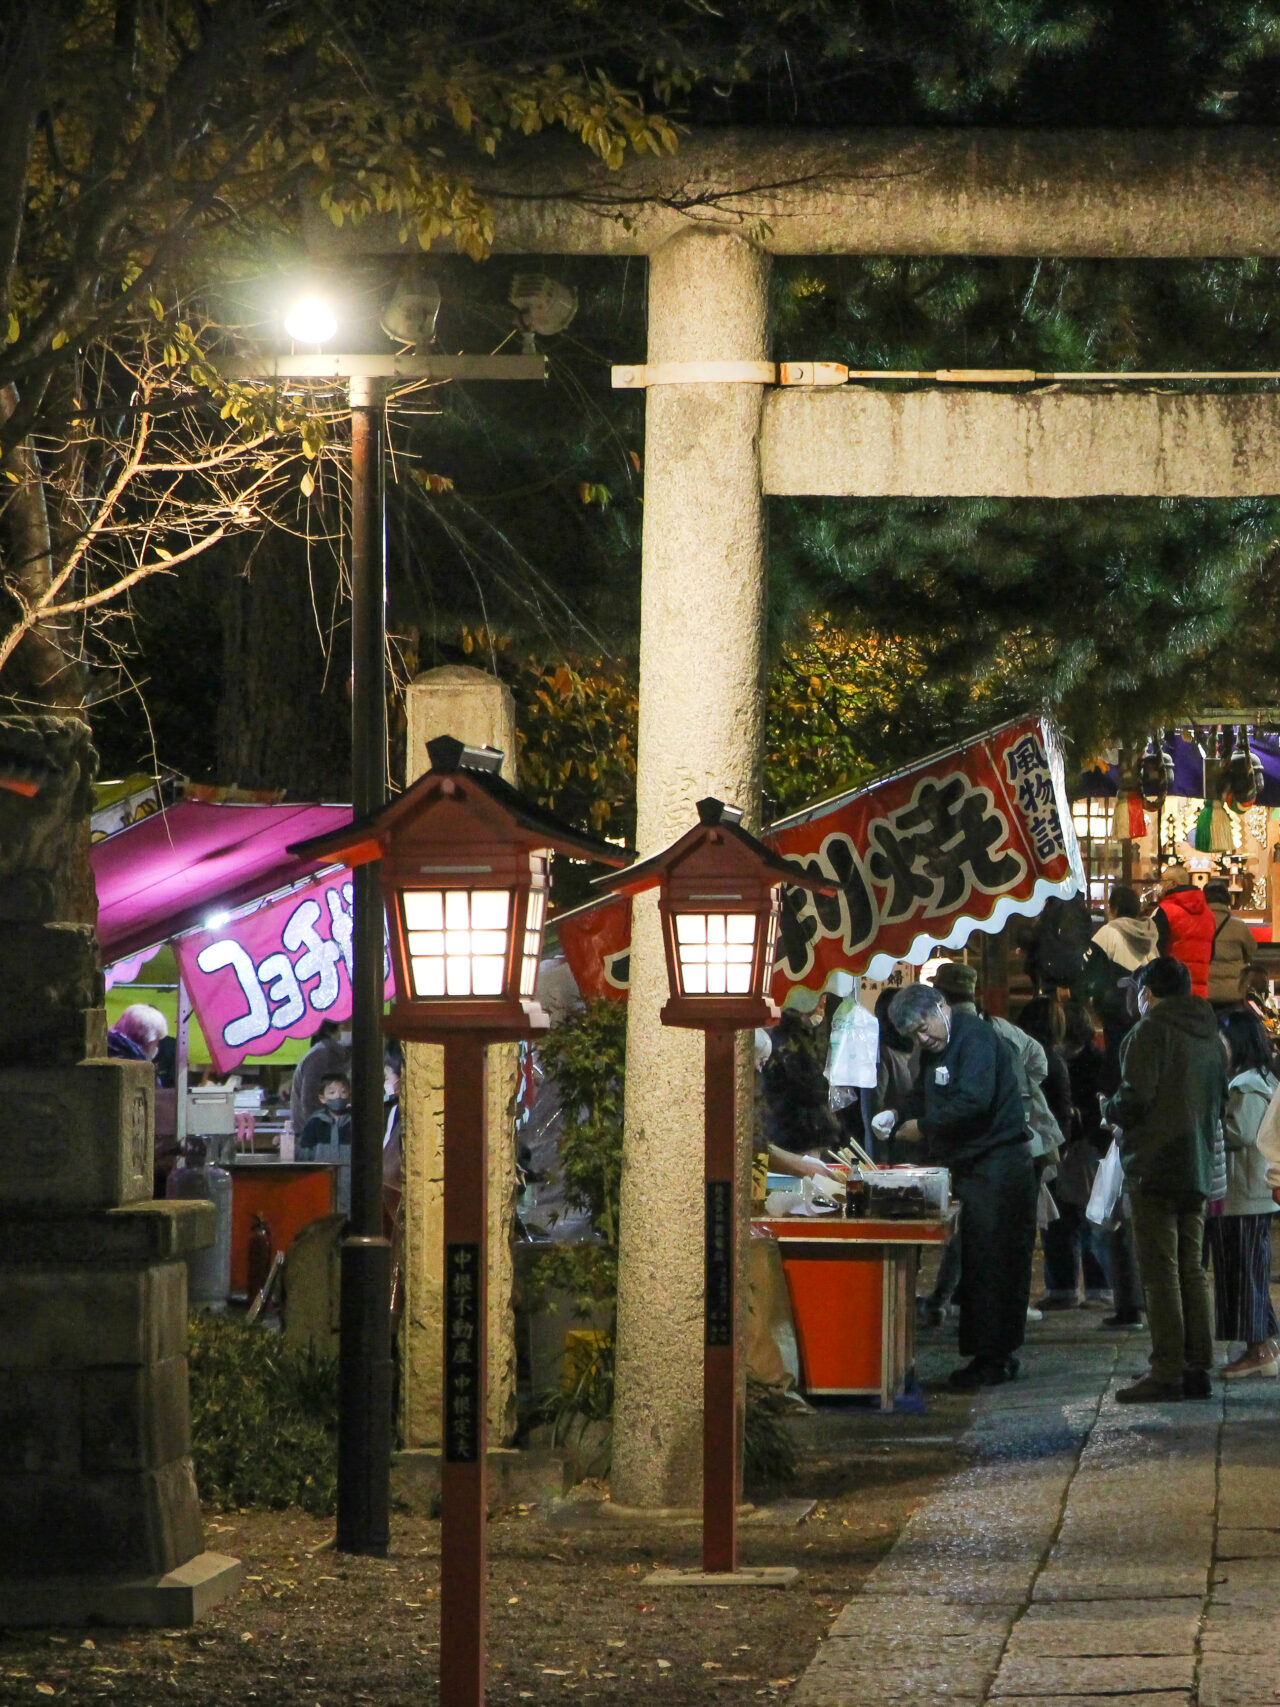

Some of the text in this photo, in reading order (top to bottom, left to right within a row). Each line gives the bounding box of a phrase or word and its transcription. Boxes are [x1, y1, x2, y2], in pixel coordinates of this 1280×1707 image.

[1005, 733, 1064, 862] 風物詩
[452, 1249, 473, 1364] 中根不動産
